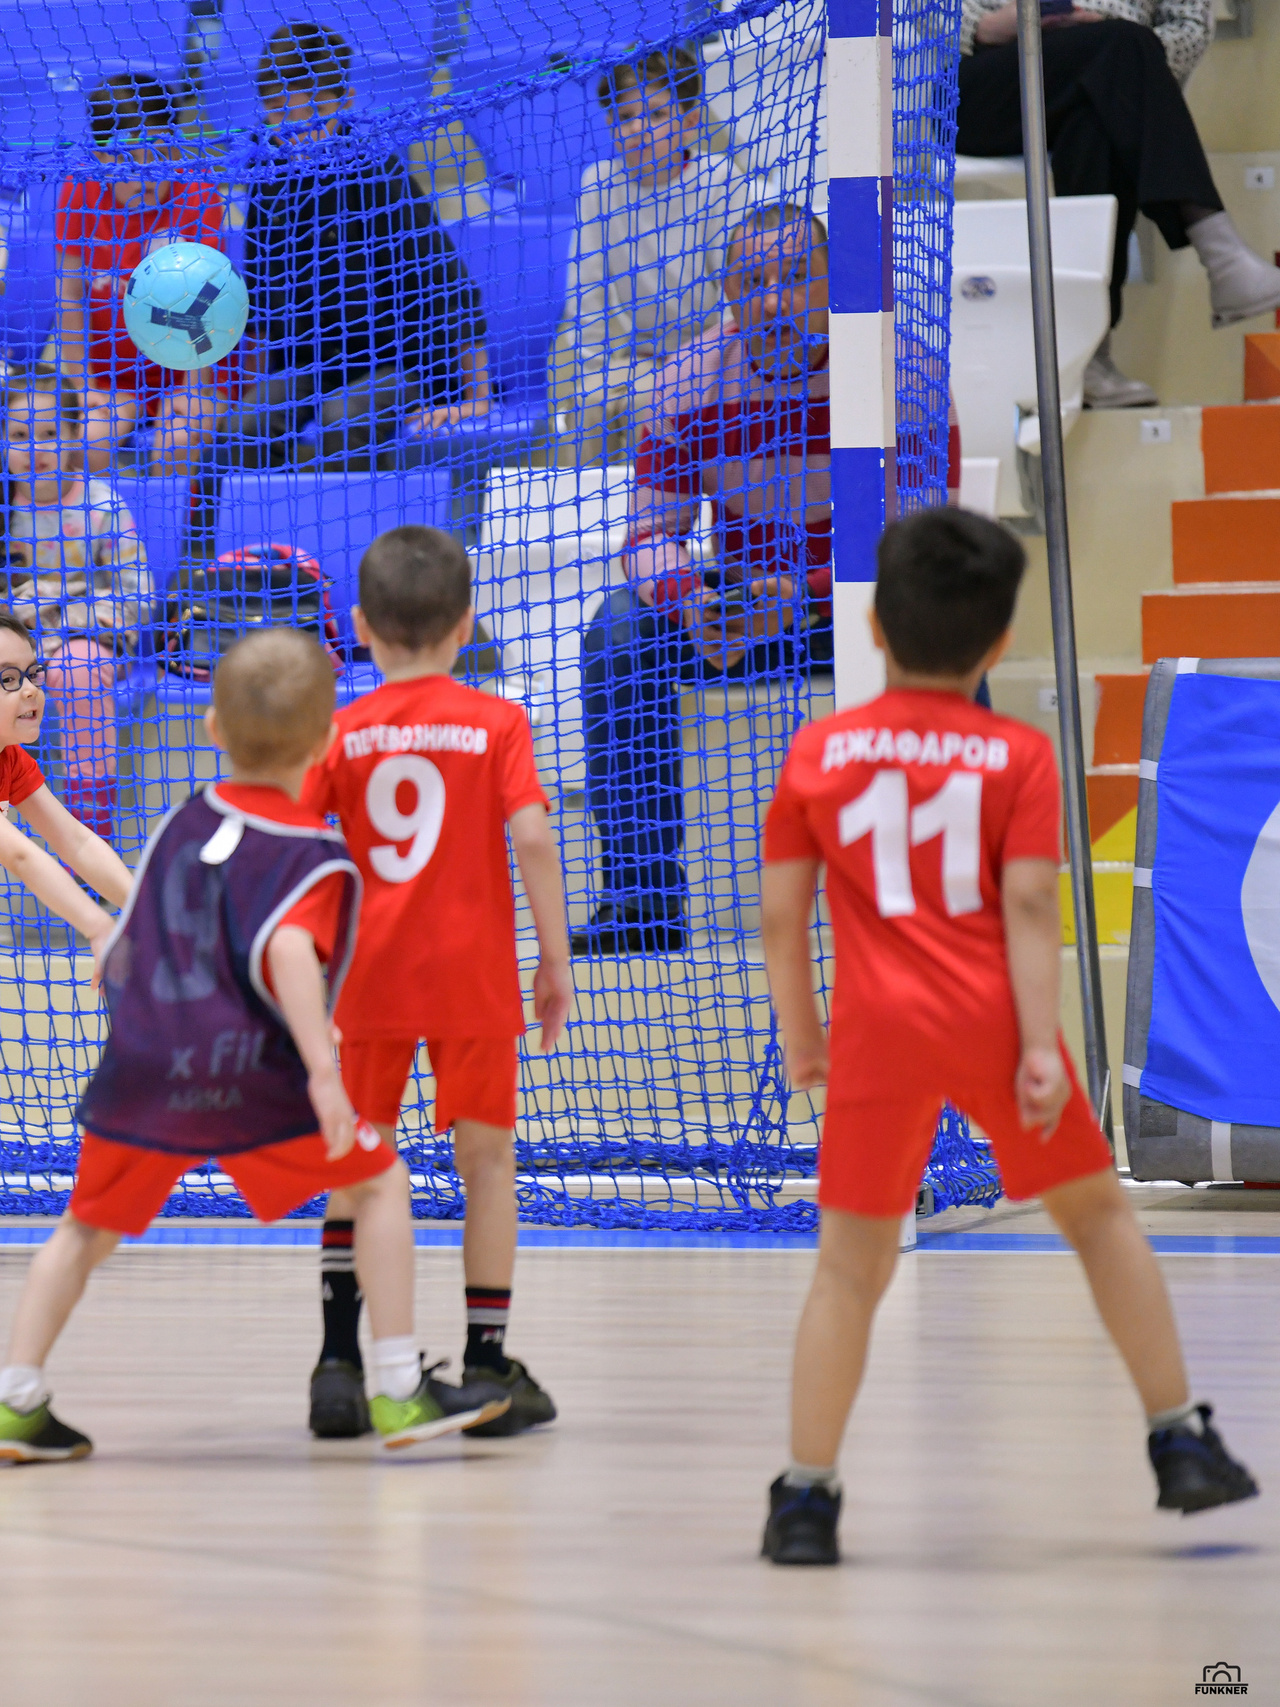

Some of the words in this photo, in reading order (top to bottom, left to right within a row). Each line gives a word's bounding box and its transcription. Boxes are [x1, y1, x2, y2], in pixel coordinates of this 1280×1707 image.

[821, 727, 1009, 774] ДЖАФАРОВ
[365, 753, 446, 885] 9
[838, 768, 983, 918] 11
